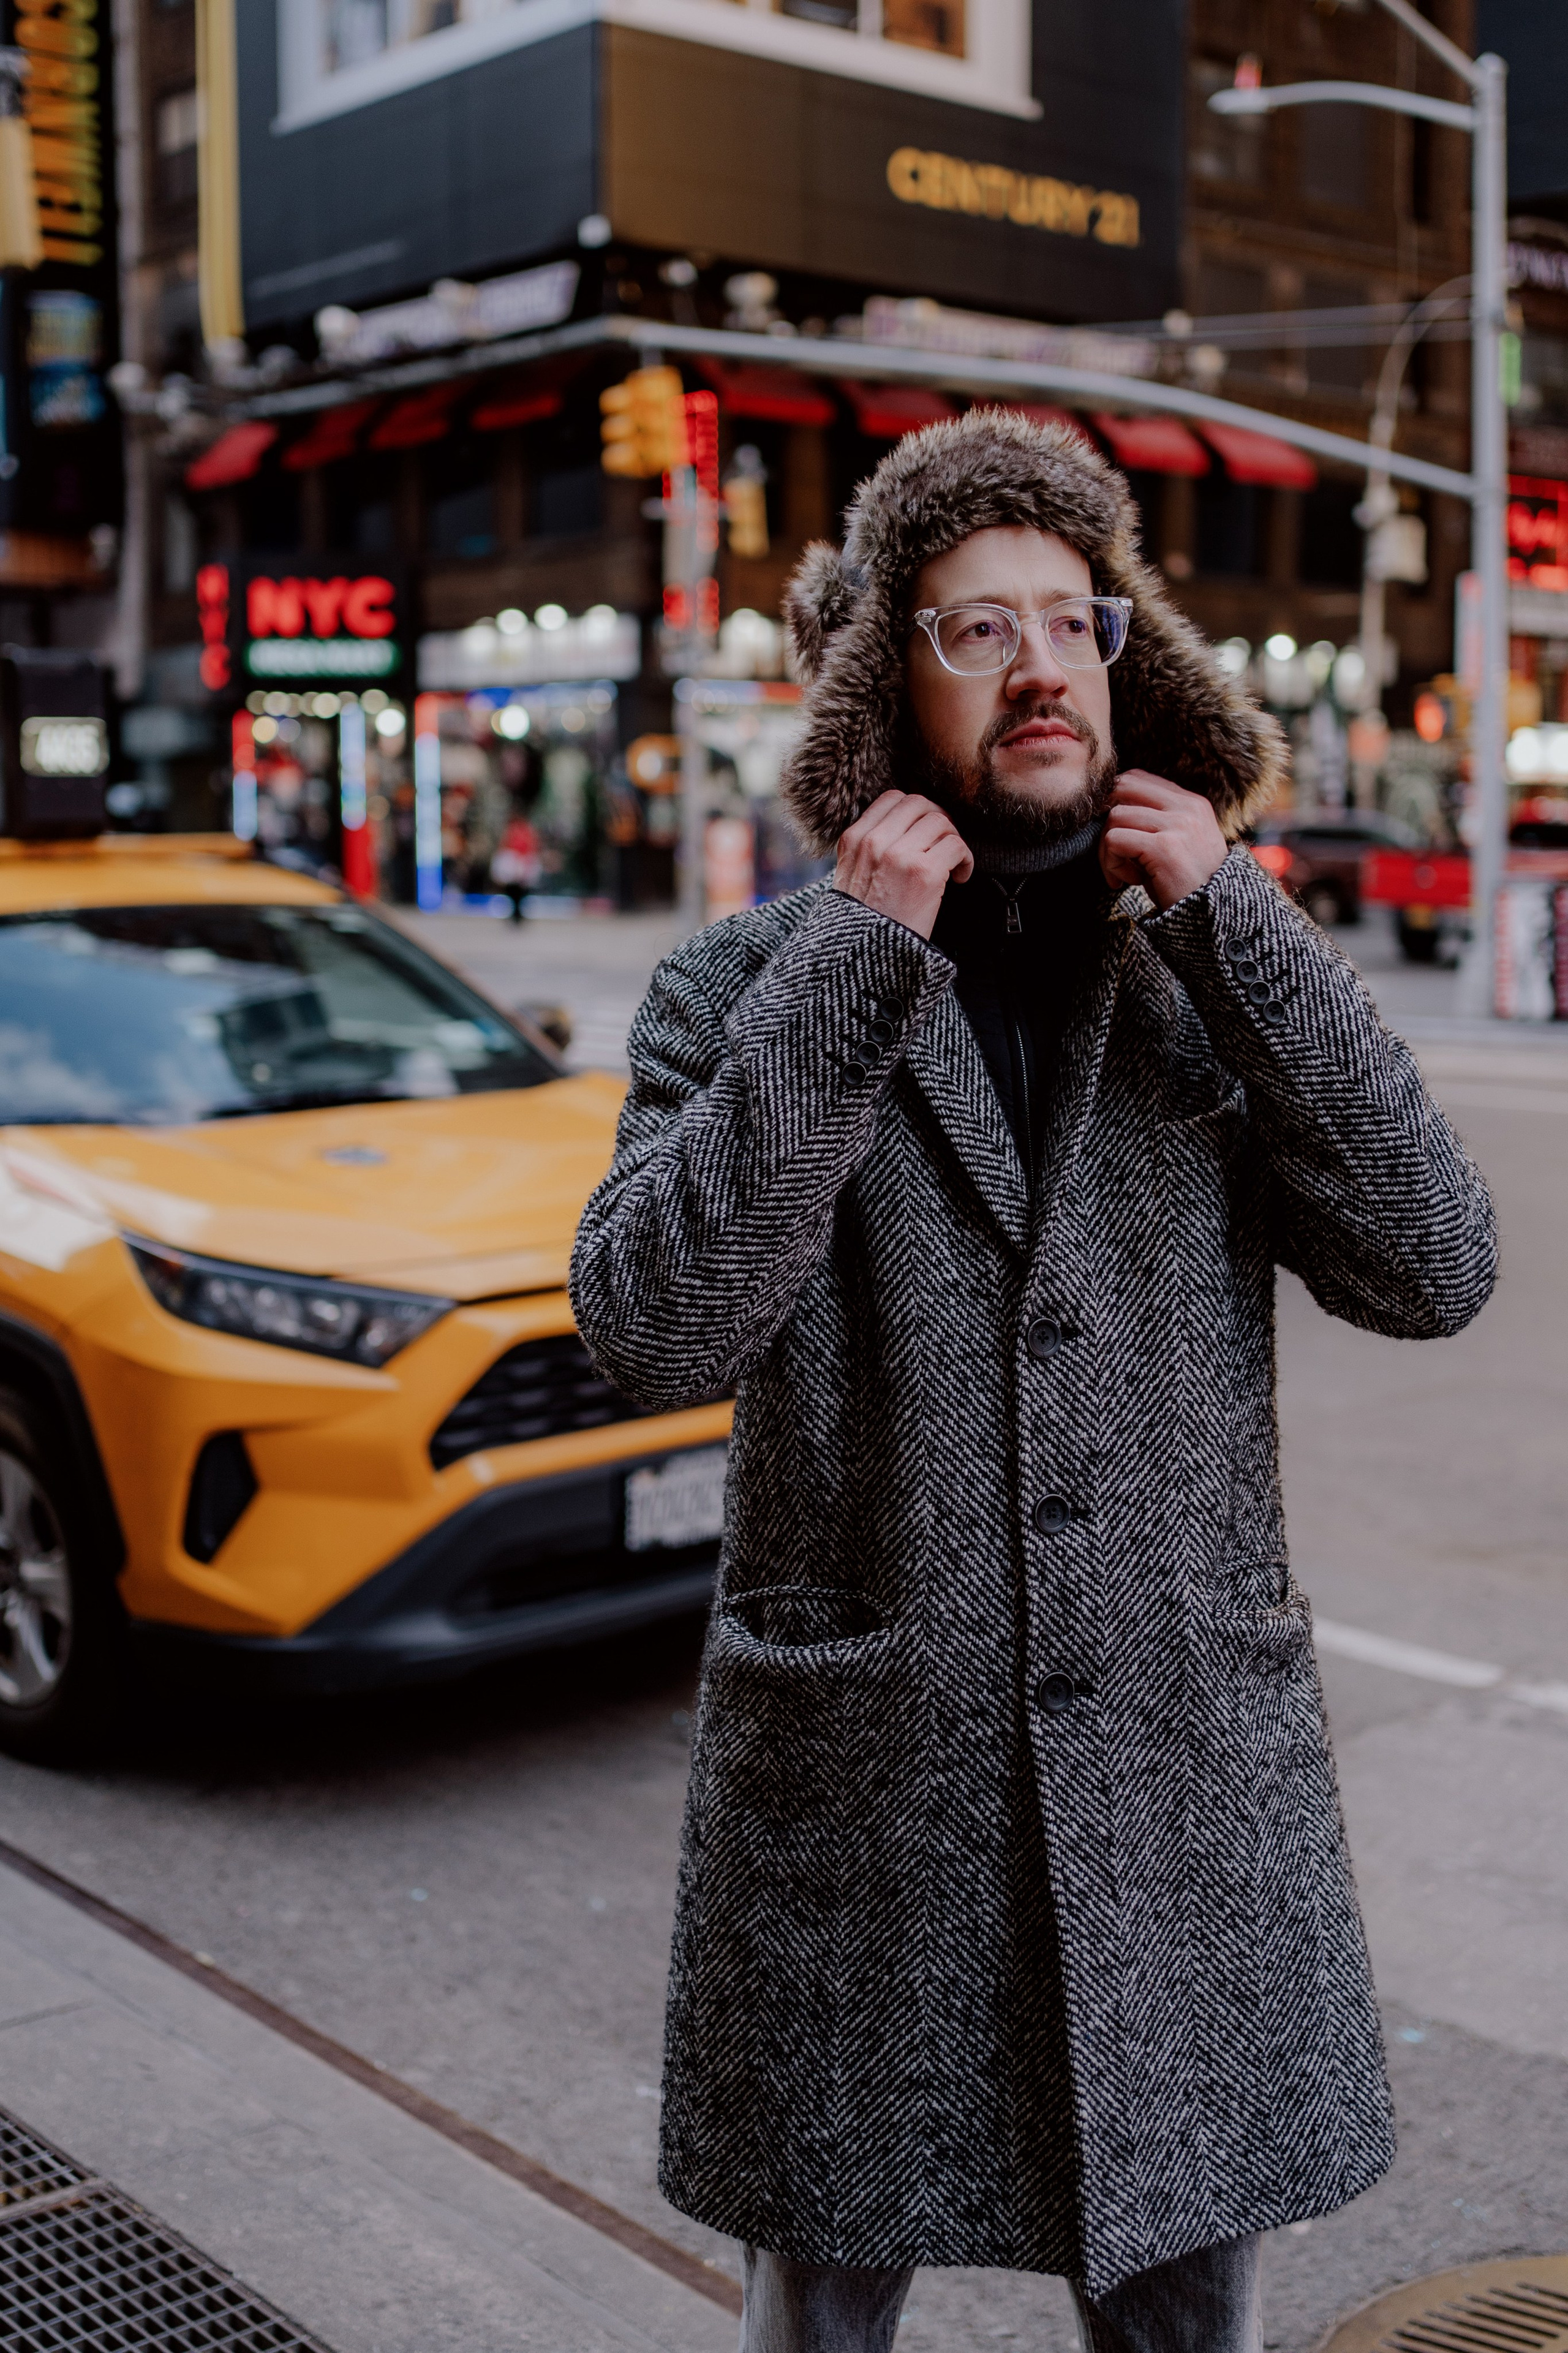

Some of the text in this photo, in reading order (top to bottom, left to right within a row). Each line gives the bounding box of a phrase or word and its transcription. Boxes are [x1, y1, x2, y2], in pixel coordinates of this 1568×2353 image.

[887, 146, 1140, 246] CENTURY 21
[246, 575, 396, 639] NYC
